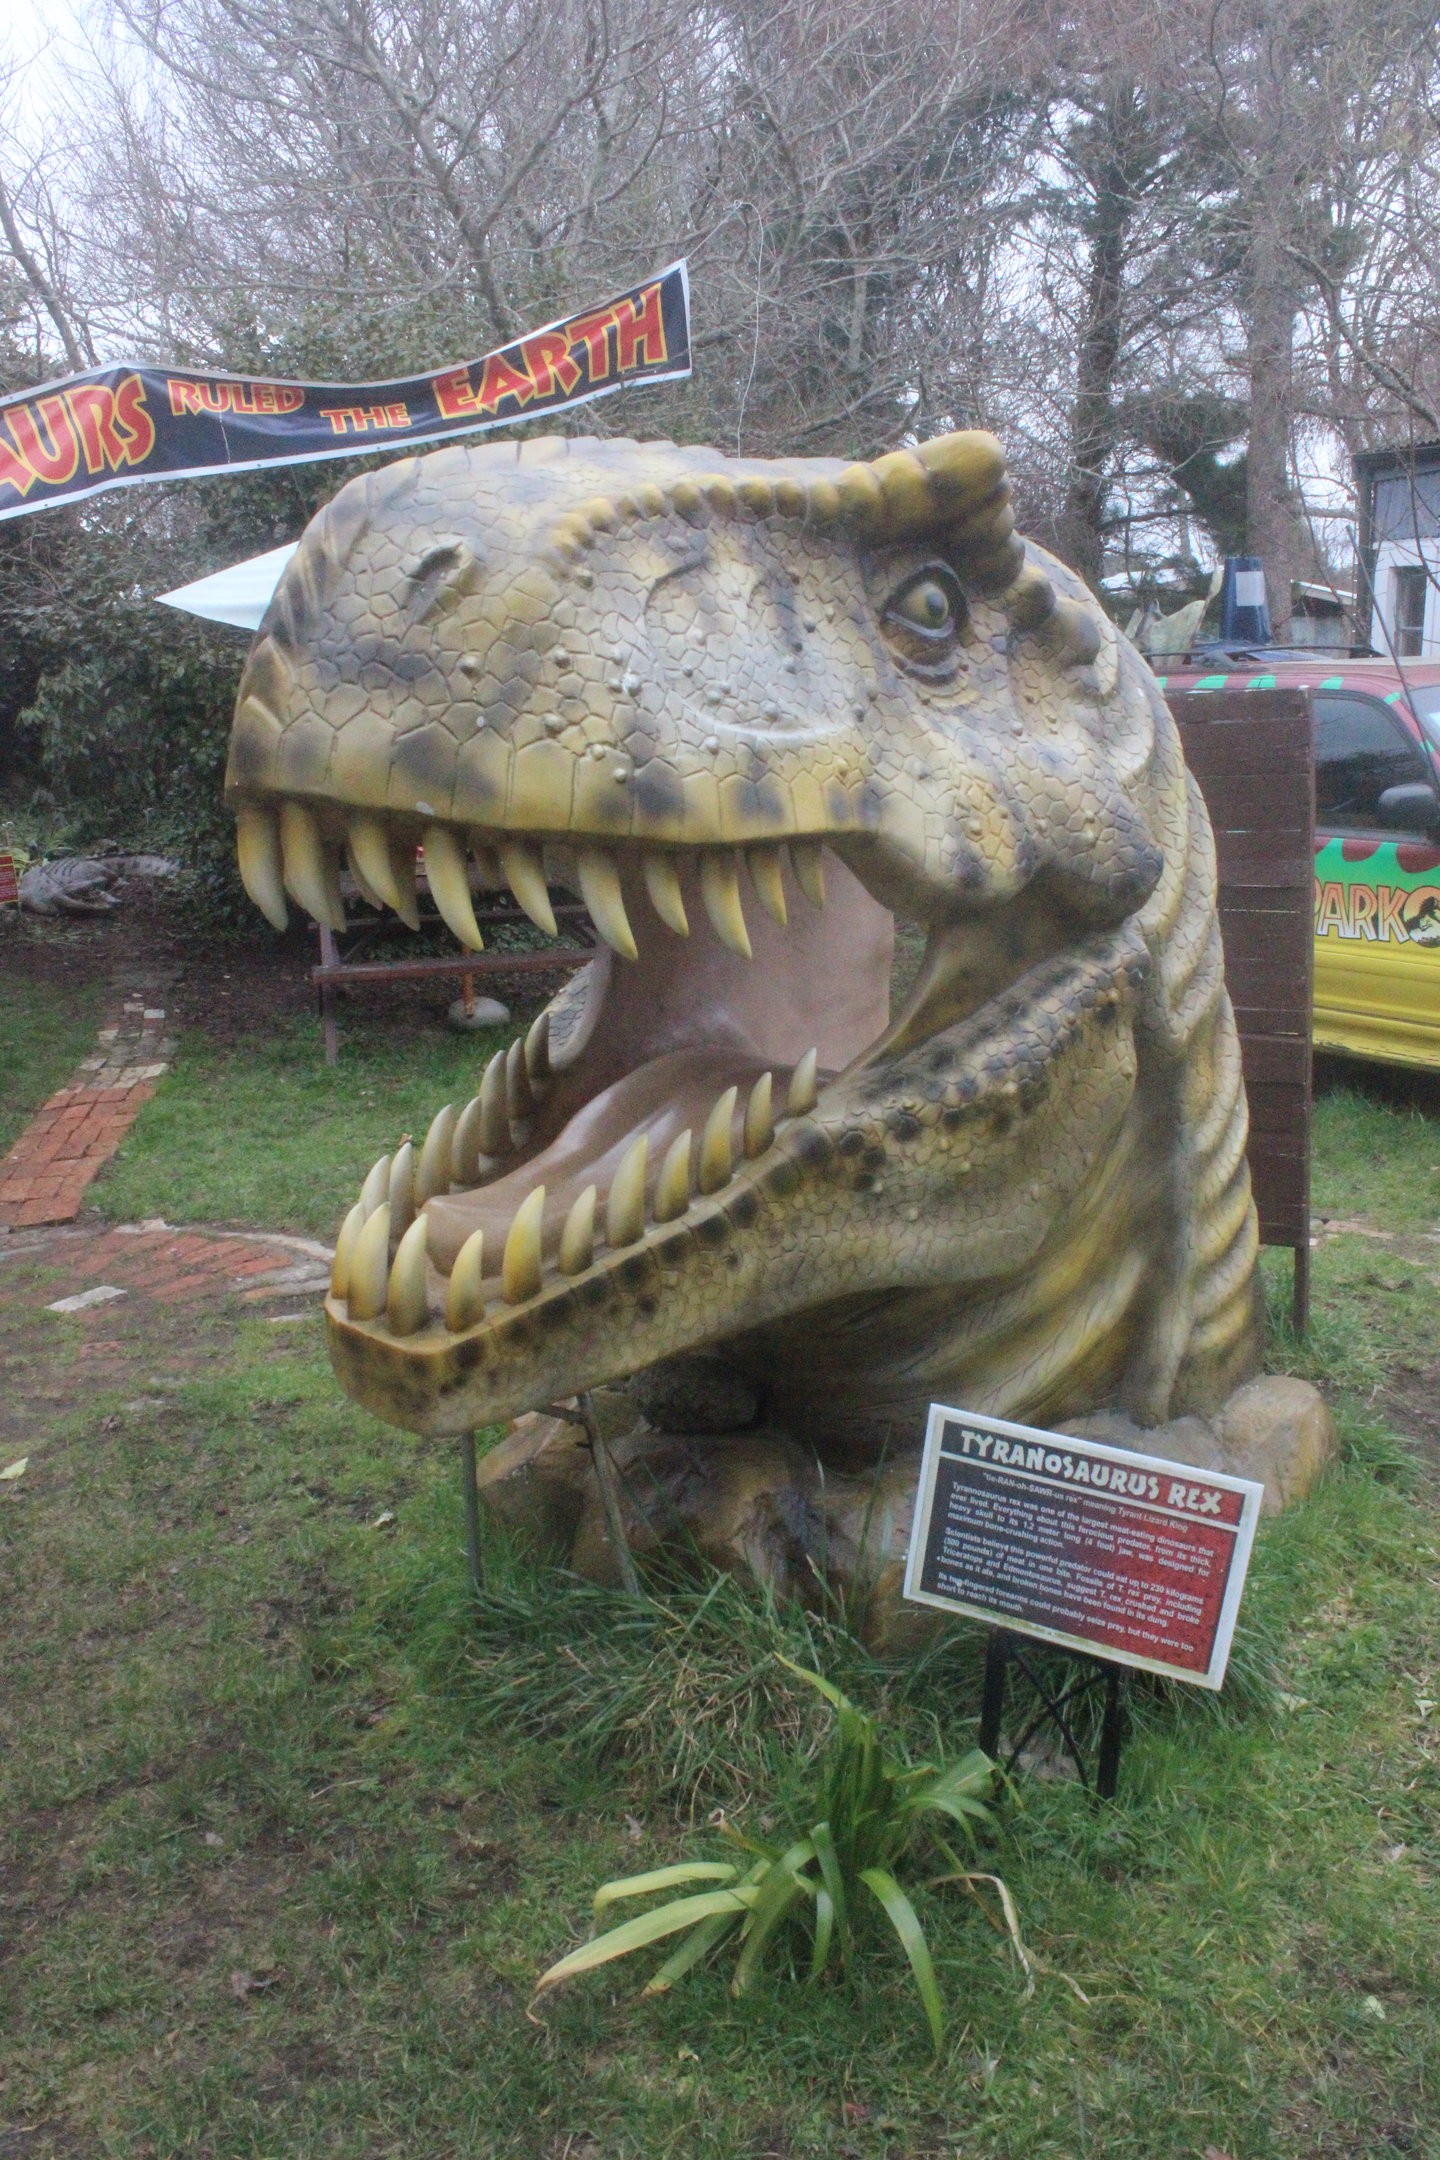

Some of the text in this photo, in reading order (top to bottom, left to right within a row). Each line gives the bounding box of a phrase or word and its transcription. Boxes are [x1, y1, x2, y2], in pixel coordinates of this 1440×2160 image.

[167, 379, 305, 416] RULED
[320, 403, 412, 434] THE
[432, 282, 668, 419] EARTH
[961, 1429, 1222, 1516] TYRANOSAURUS REX
[947, 1513, 1063, 1548] maximum bone-crushing action.
[949, 1501, 970, 1514] heavy
[975, 1509, 993, 1519] skull
[1008, 1517, 1017, 1525] its
[1038, 1527, 1059, 1536] meter
[1063, 1532, 1080, 1544] long
[1084, 1538, 1092, 1546] (4
[1096, 1541, 1114, 1553] foot)
[1138, 1554, 1153, 1562] was
[1158, 1557, 1193, 1572] designed
[1198, 1568, 1209, 1577] for
[950, 1493, 965, 1501] ever
[969, 1496, 988, 1508] lived.
[993, 1503, 1032, 1521] Everything
[1036, 1515, 1057, 1526] about
[1060, 1521, 1074, 1530] this
[1078, 1525, 1113, 1541] ferocious
[1154, 1546, 1172, 1557] from
[1176, 1551, 1186, 1560] its
[952, 1481, 1006, 1502] Tyrannosaurus
[1009, 1498, 1020, 1506] rex
[1023, 1502, 1037, 1510] was
[1040, 1507, 1054, 1515] one
[1067, 1512, 1079, 1521] the
[1081, 1515, 1107, 1529] largest
[1110, 1525, 1154, 1543] meat-eating
[1157, 1535, 1195, 1552] dinosaurs
[1198, 1547, 1213, 1556] that
[1083, 1500, 1115, 1515] meaning
[1117, 1507, 1142, 1520] Tyrant
[1143, 1513, 1167, 1526] Lizard
[1169, 1520, 1187, 1533] King
[937, 1583, 956, 1592] short
[966, 1591, 986, 1601] reach
[988, 1596, 996, 1604] its
[998, 1601, 1022, 1612] mouth.
[941, 1556, 963, 1567] bones
[996, 1573, 1010, 1581] and
[1012, 1576, 1036, 1588] broken
[1039, 1584, 1061, 1595] bones
[1064, 1591, 1081, 1601] have
[1083, 1596, 1101, 1607] been
[1103, 1602, 1125, 1613] found
[1127, 1608, 1134, 1616] in
[1135, 1611, 1145, 1619] its
[1147, 1614, 1167, 1627] dung.
[943, 1536, 959, 1546] (500
[962, 1543, 992, 1557] pounds)
[1007, 1556, 1024, 1564] meat
[1038, 1564, 1052, 1572] one
[1056, 1568, 1070, 1577] bite.
[1076, 1573, 1102, 1586] Fossils
[1165, 1598, 1201, 1615] including
[943, 1547, 982, 1563] Triceratops
[986, 1560, 999, 1568] and
[1067, 1583, 1096, 1595] suggest
[1125, 1599, 1156, 1611] crushed
[1177, 1612, 1199, 1624] broke
[945, 1527, 980, 1542] Scientists
[1010, 1546, 1023, 1554] this
[1025, 1551, 1058, 1564] powerful
[1059, 1560, 1090, 1573] predator
[1093, 1569, 1114, 1579] could
[1115, 1575, 1127, 1583] eat
[1129, 1579, 1138, 1587] up
[1150, 1583, 1164, 1593] 230
[1165, 1588, 1203, 1604] kilograms
[938, 1572, 946, 1580] Its
[995, 1588, 1027, 1603] forearms
[1030, 1600, 1050, 1609] could
[1051, 1606, 1084, 1621] probably
[1128, 1626, 1140, 1635] but
[1142, 1631, 1158, 1642] they
[1161, 1637, 1178, 1646] were
[1181, 1642, 1193, 1651] too
